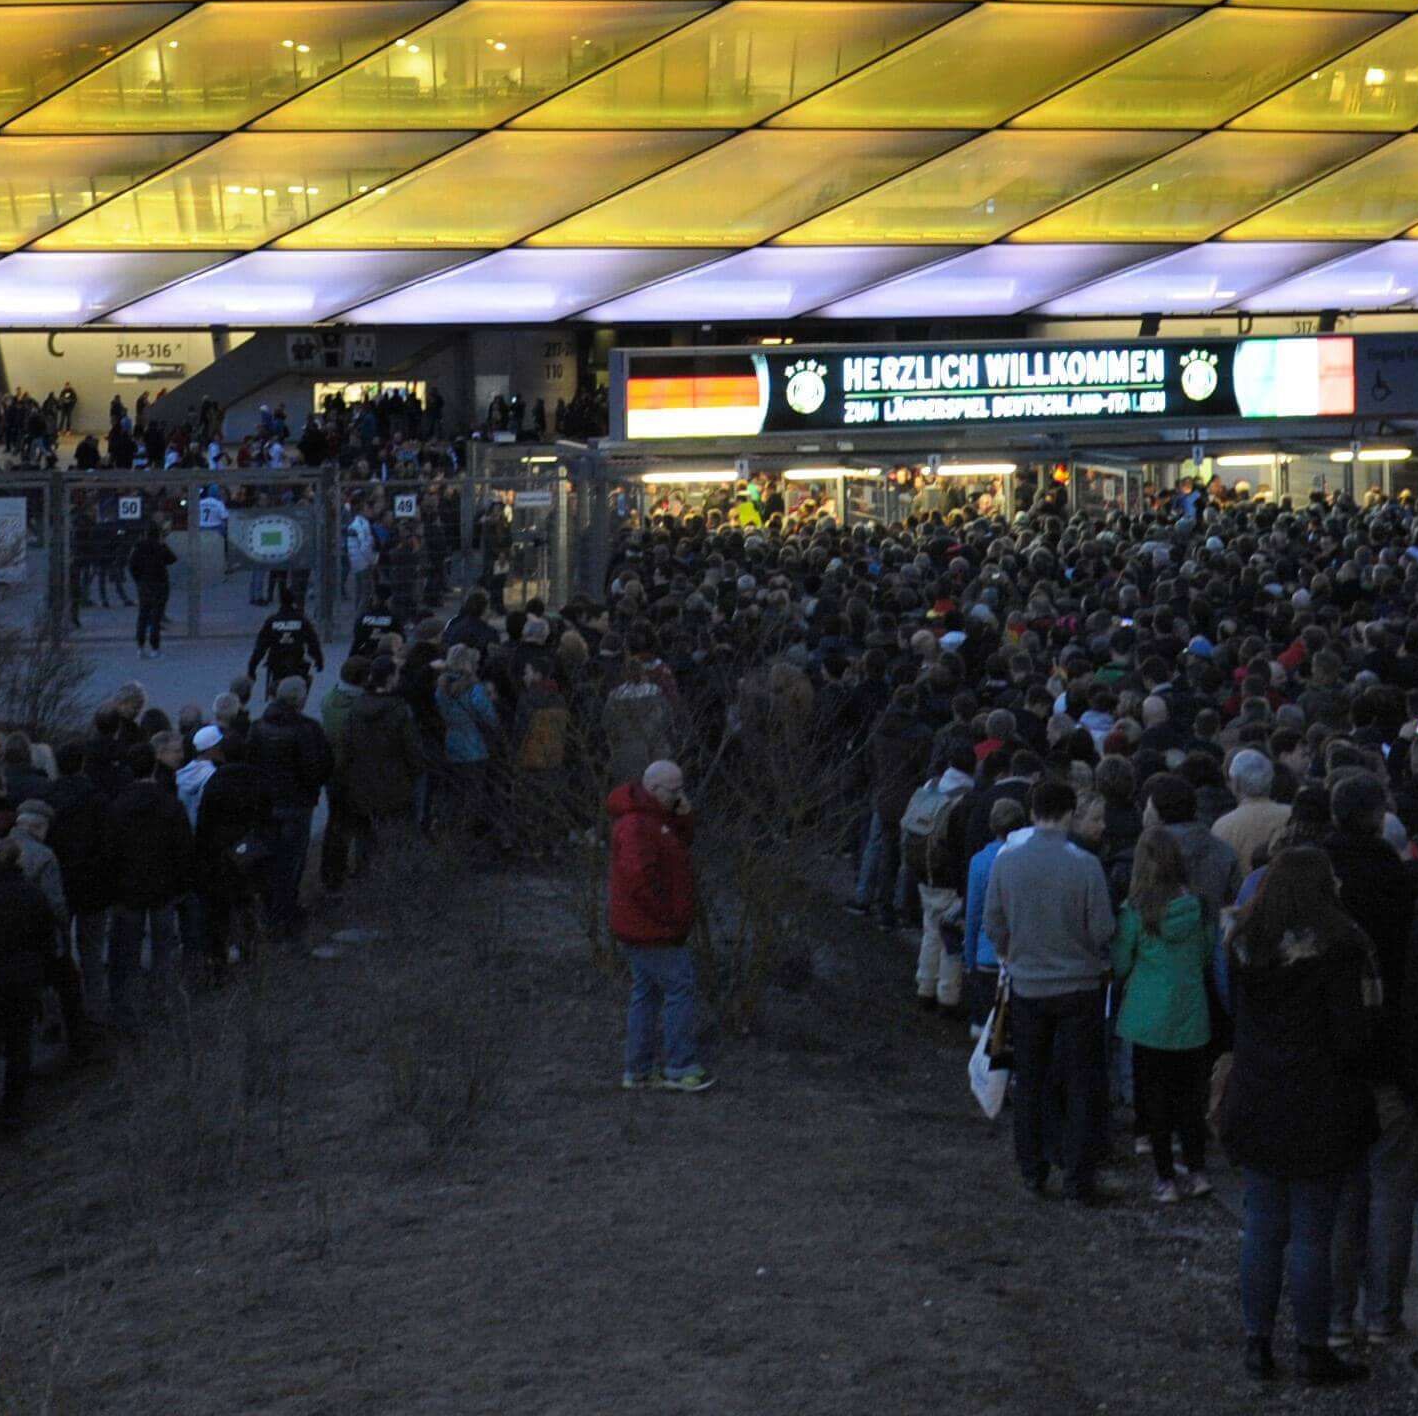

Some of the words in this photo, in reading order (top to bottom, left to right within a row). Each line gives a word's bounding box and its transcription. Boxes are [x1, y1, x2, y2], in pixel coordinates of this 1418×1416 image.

[115, 343, 172, 358] 314-316
[843, 353, 978, 391] HERZLICH
[985, 349, 1165, 386] WILLKOMMEN
[843, 400, 879, 423] ZUM
[884, 395, 990, 421] LÄNDERSPIEL
[992, 391, 1166, 418] DEUTSCHLAND-ITALIEN
[122, 501, 138, 514] 50
[397, 498, 413, 513] 49
